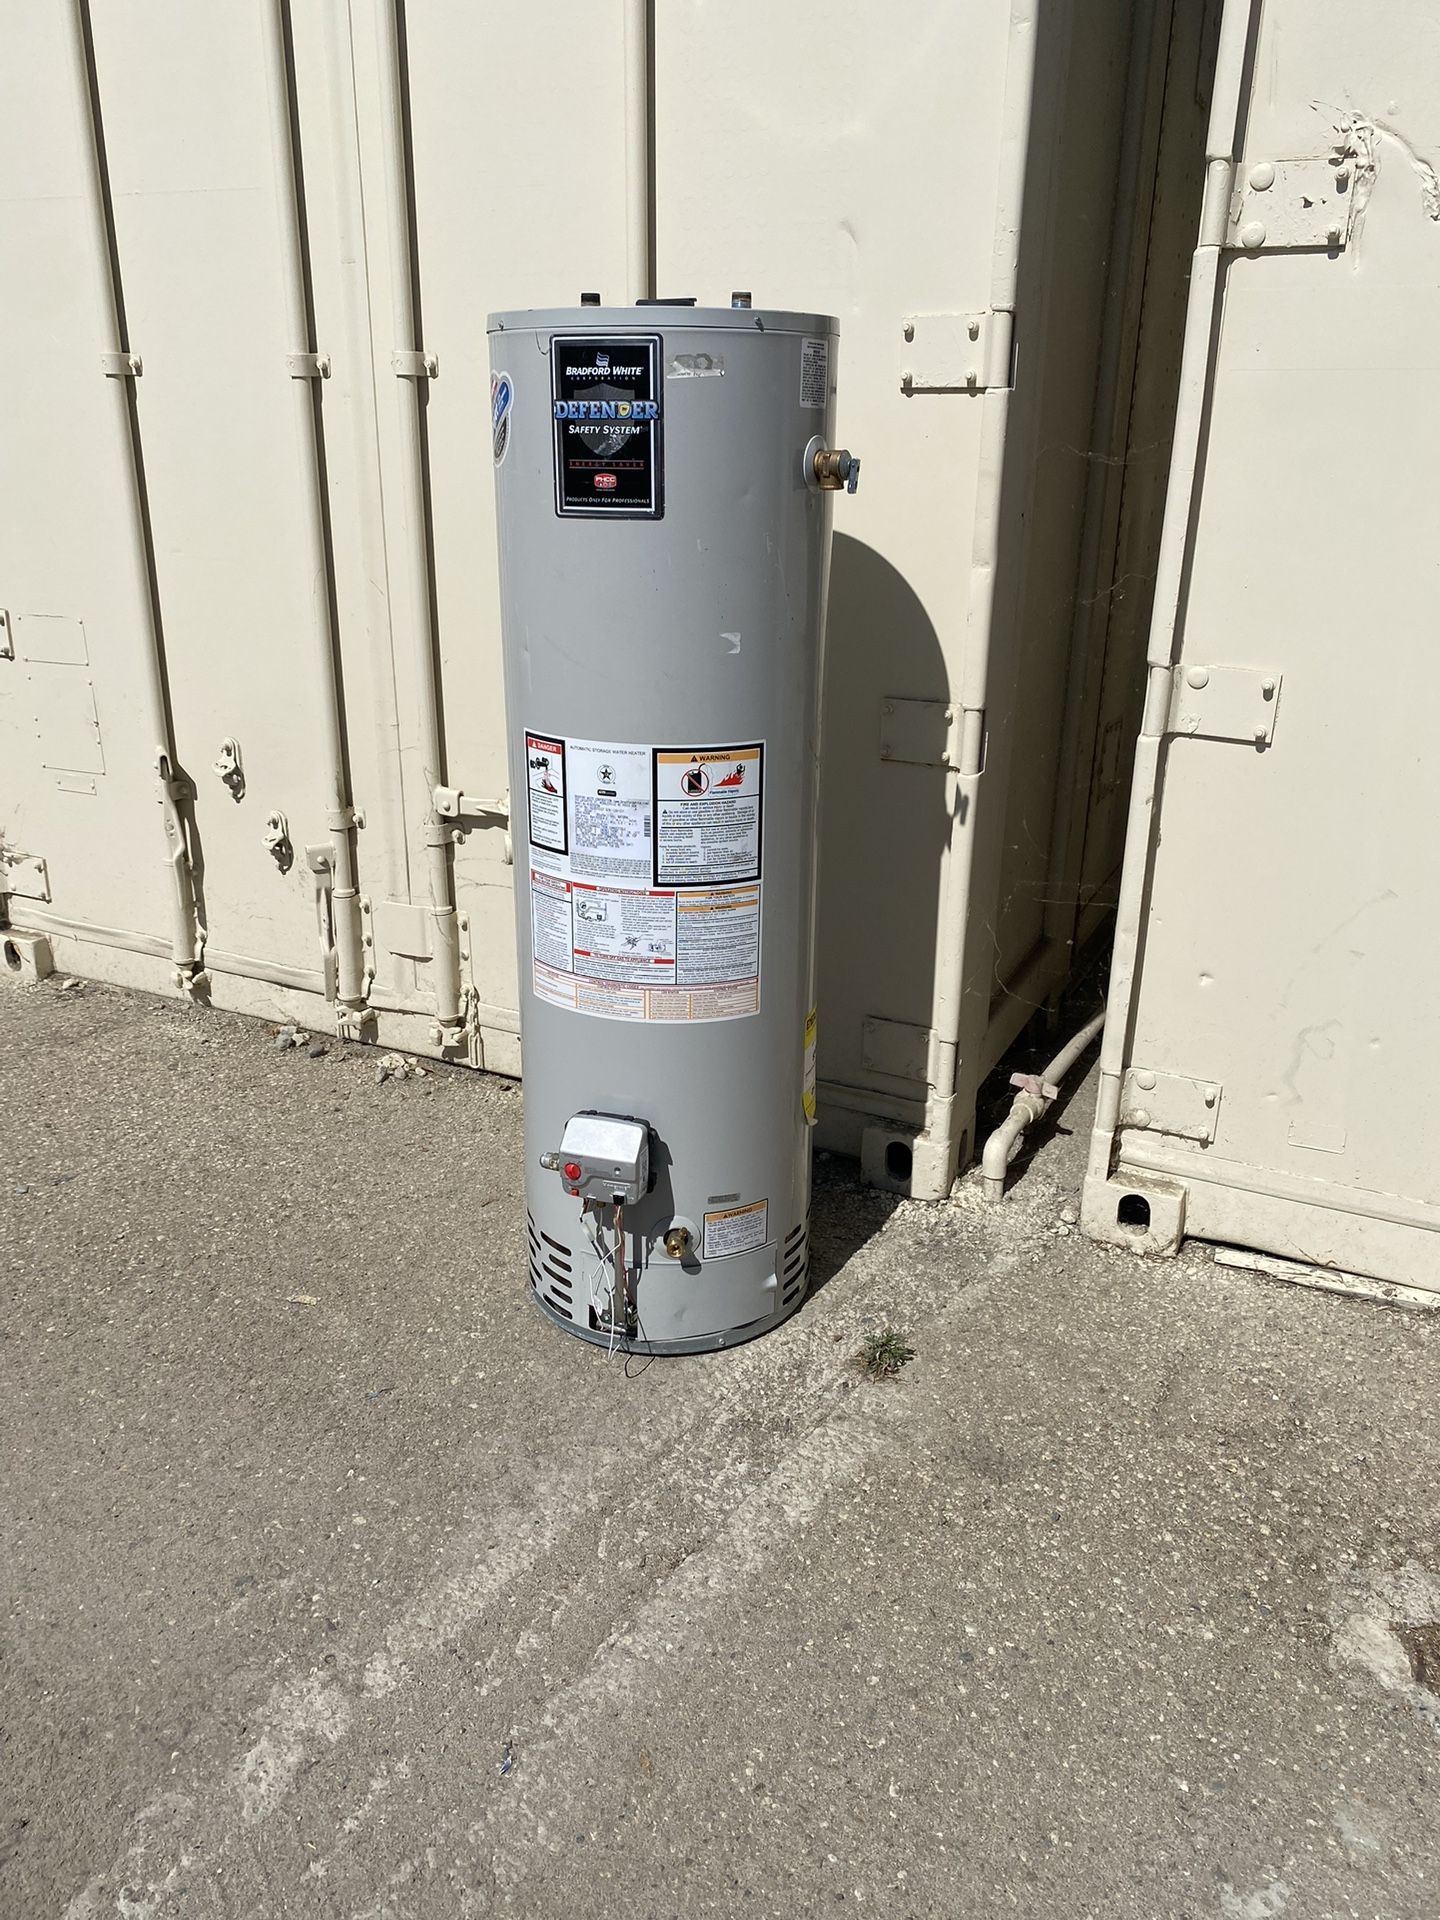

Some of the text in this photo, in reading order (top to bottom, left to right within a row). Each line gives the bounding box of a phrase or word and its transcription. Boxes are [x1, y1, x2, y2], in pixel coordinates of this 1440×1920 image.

[566, 366, 642, 376] BRADFORD WHITE
[555, 401, 658, 419] DEFENDER
[568, 425, 640, 435] SAFETY SYSTEM
[537, 742, 557, 752] DANGER
[728, 1208, 752, 1217] WARNING
